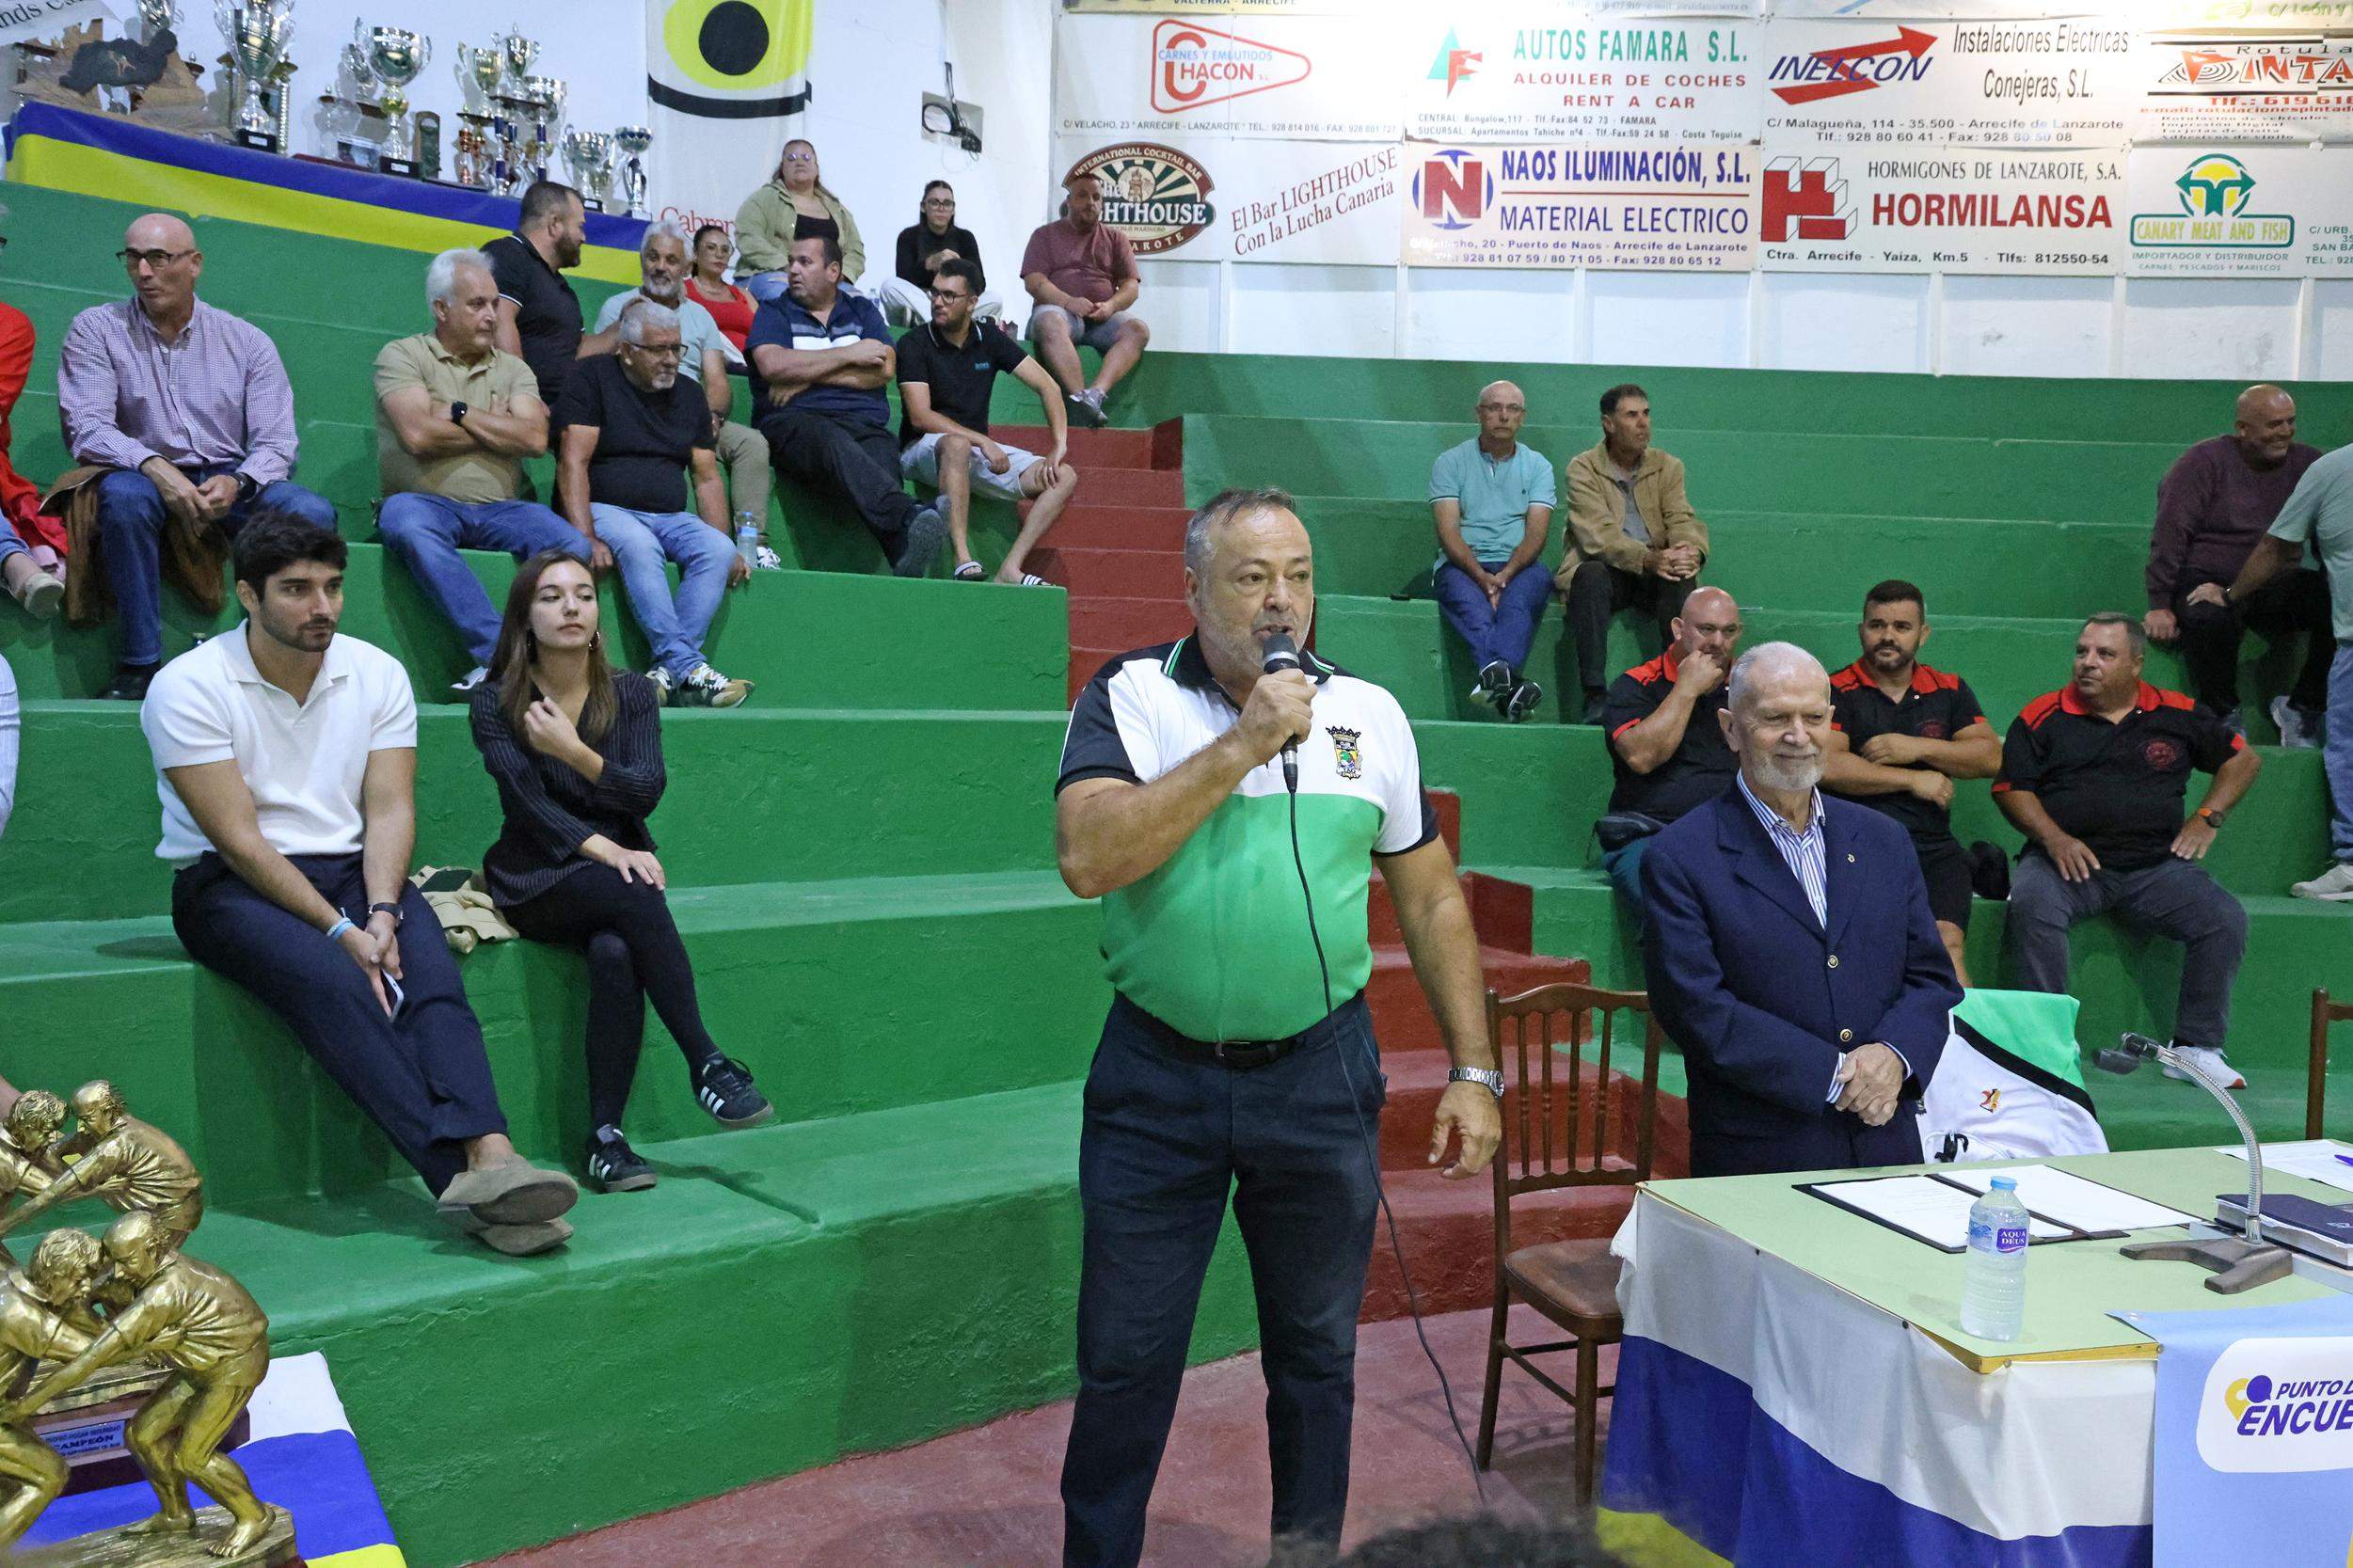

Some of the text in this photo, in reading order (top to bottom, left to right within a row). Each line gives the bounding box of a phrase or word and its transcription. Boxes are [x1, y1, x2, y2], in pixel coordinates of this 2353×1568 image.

[0, 3, 41, 28] nds
[1513, 29, 1748, 63] AUTOS FAMARA S.L.
[1953, 24, 2053, 54] Instalaciones
[1158, 50, 1272, 61] CARNES Y EMBUTIDOS
[2236, 45, 2353, 55] Rotula
[1769, 55, 1934, 82] INELCON
[1513, 72, 1747, 87] ALQUILER DE COCHES
[1984, 69, 2094, 106] Conejeras, S.L.
[1563, 95, 1696, 108] RENT A CAR
[2211, 96, 2256, 106] Tlf.:
[2264, 96, 2309, 105] 619
[1120, 121, 1130, 130] 23
[1137, 121, 1180, 130] ARRECIFE
[1188, 121, 1241, 131] LANZAROTE
[1271, 123, 1286, 132] 928
[1598, 116, 1610, 124] 73
[1620, 117, 1657, 125] FAMARA
[1767, 118, 2124, 132] C/ Malagueña, 114 35.500 Arrecife de Lanzarote
[1471, 127, 1529, 137] Apartamentos
[1534, 128, 1566, 136] Tahiche
[1645, 130, 1655, 138] 24
[1682, 131, 1707, 139] Costa
[1710, 131, 1742, 140] Teguise
[1816, 132, 1842, 142] Tlf.:
[1847, 133, 1871, 142] 928
[1877, 133, 1893, 142] 80
[1897, 133, 1914, 142] 60
[1918, 133, 1933, 142] 41
[1948, 132, 1979, 142] Fax:
[1983, 133, 2009, 142] 928
[2056, 133, 2073, 142] 08
[1074, 148, 1203, 180] INTERNATIONAL COCKTAIL BAR
[1502, 147, 1751, 188] NAOS ILUMINACIÓN, S.L.
[1868, 161, 2121, 182] HORMIGONES DE LANZAROTE, S.A.
[1100, 180, 1122, 198] he
[1231, 147, 1398, 232] El Bar LIGHTHOUSE
[1098, 202, 1206, 225] HTHOUSE
[1234, 177, 1394, 256] Con la Lucha Canaria
[1500, 206, 1749, 234] MATERIAL ELECTRICO
[1872, 194, 2112, 229] HORMILANSA
[2137, 221, 2288, 242] CANARY MEAT AND FISH
[2309, 226, 2321, 234] C/
[1129, 232, 1184, 251] AROTE
[1483, 239, 1497, 248] 20
[1507, 240, 1548, 249] Puerto
[1552, 240, 1567, 249] de
[1571, 241, 1602, 249] Naos
[1614, 241, 1663, 251] Arrecife
[1667, 242, 1682, 251] de
[1686, 243, 1748, 252] Lanzarote
[1463, 253, 1485, 262] 928
[1489, 253, 1502, 262] 81
[1507, 254, 1522, 262] 07
[1526, 254, 1540, 263] 59
[1550, 254, 1566, 263] 80
[1569, 255, 1584, 263] 71
[1588, 255, 1602, 263] 05
[1614, 256, 1640, 264] Fax:
[1644, 256, 1666, 264] 928
[1670, 256, 1685, 264] 80
[1708, 256, 1722, 265] 12
[1767, 249, 2108, 264] Ctra. Arrecife Yaiza, Km.5 Tlfs: 812550-54
[2132, 252, 2202, 261] IMPORTADOR
[2276, 1380, 2344, 1400] PUNTO
[2237, 1400, 2353, 1436] ENCUE
